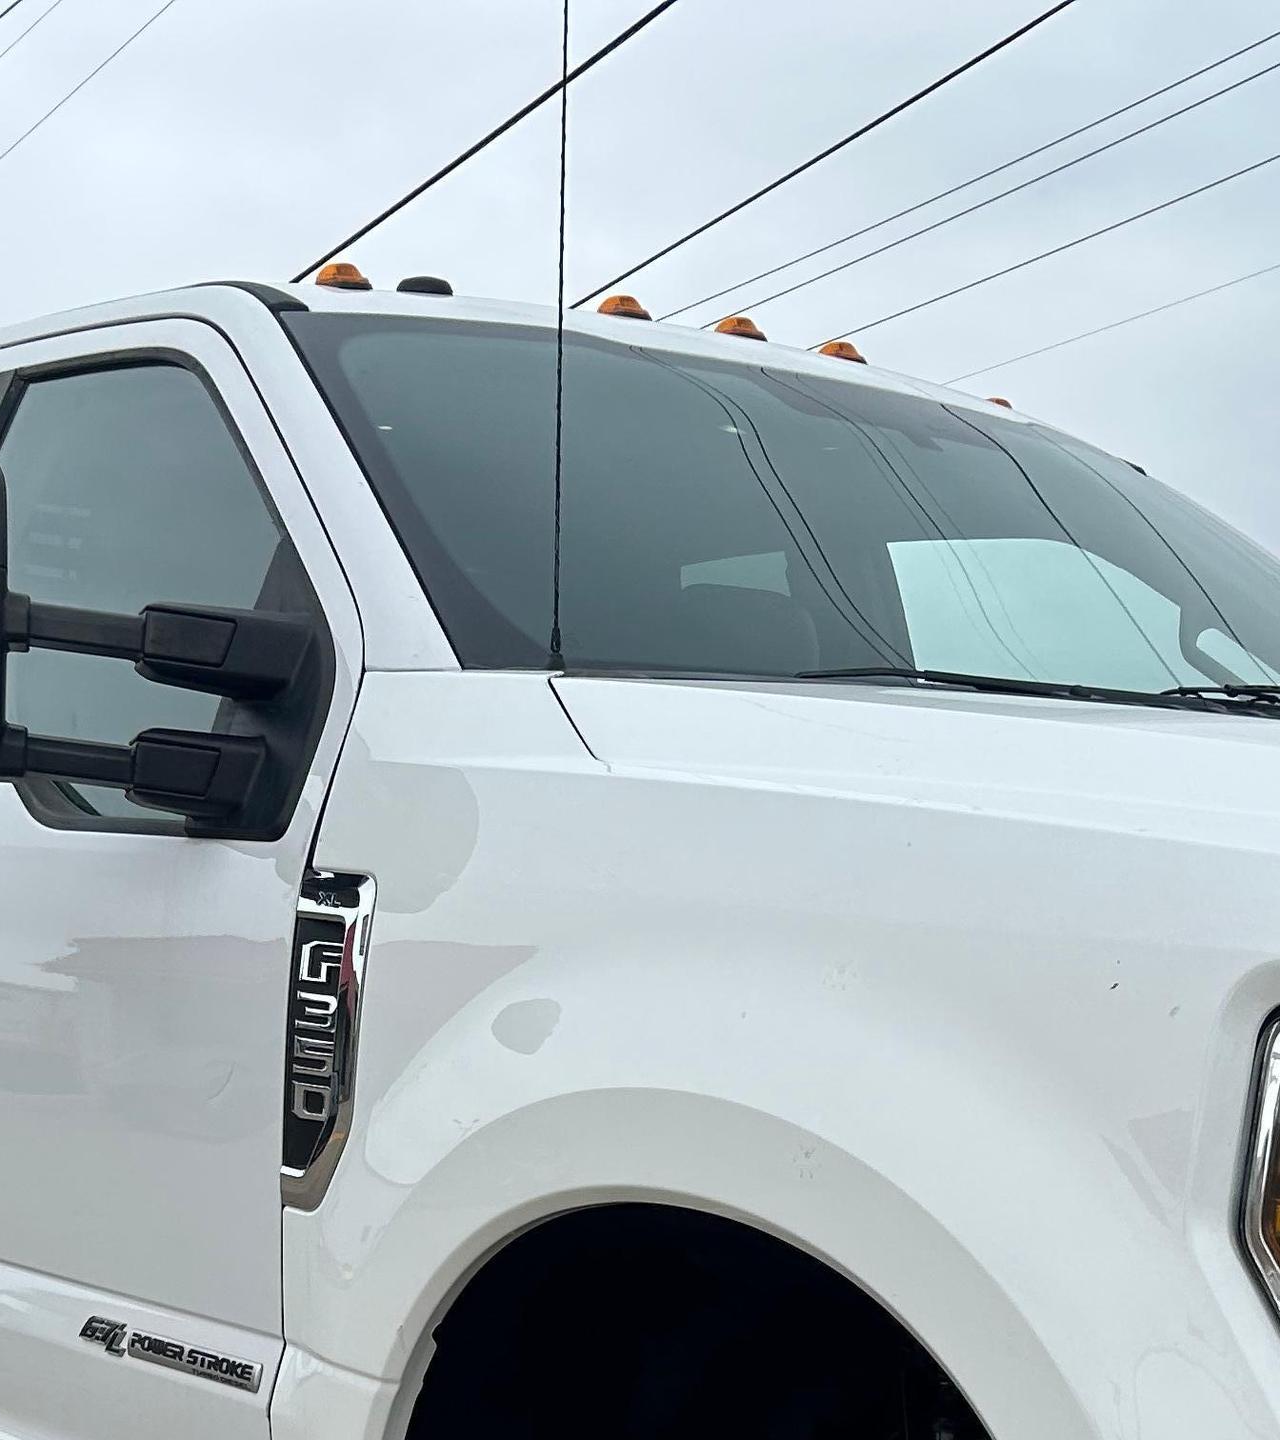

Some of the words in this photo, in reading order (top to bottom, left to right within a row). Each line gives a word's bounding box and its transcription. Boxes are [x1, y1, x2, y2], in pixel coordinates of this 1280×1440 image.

[317, 891, 341, 907] XL
[291, 940, 344, 1122] F350
[130, 1331, 185, 1362] POWER
[186, 1348, 254, 1382] STROKE
